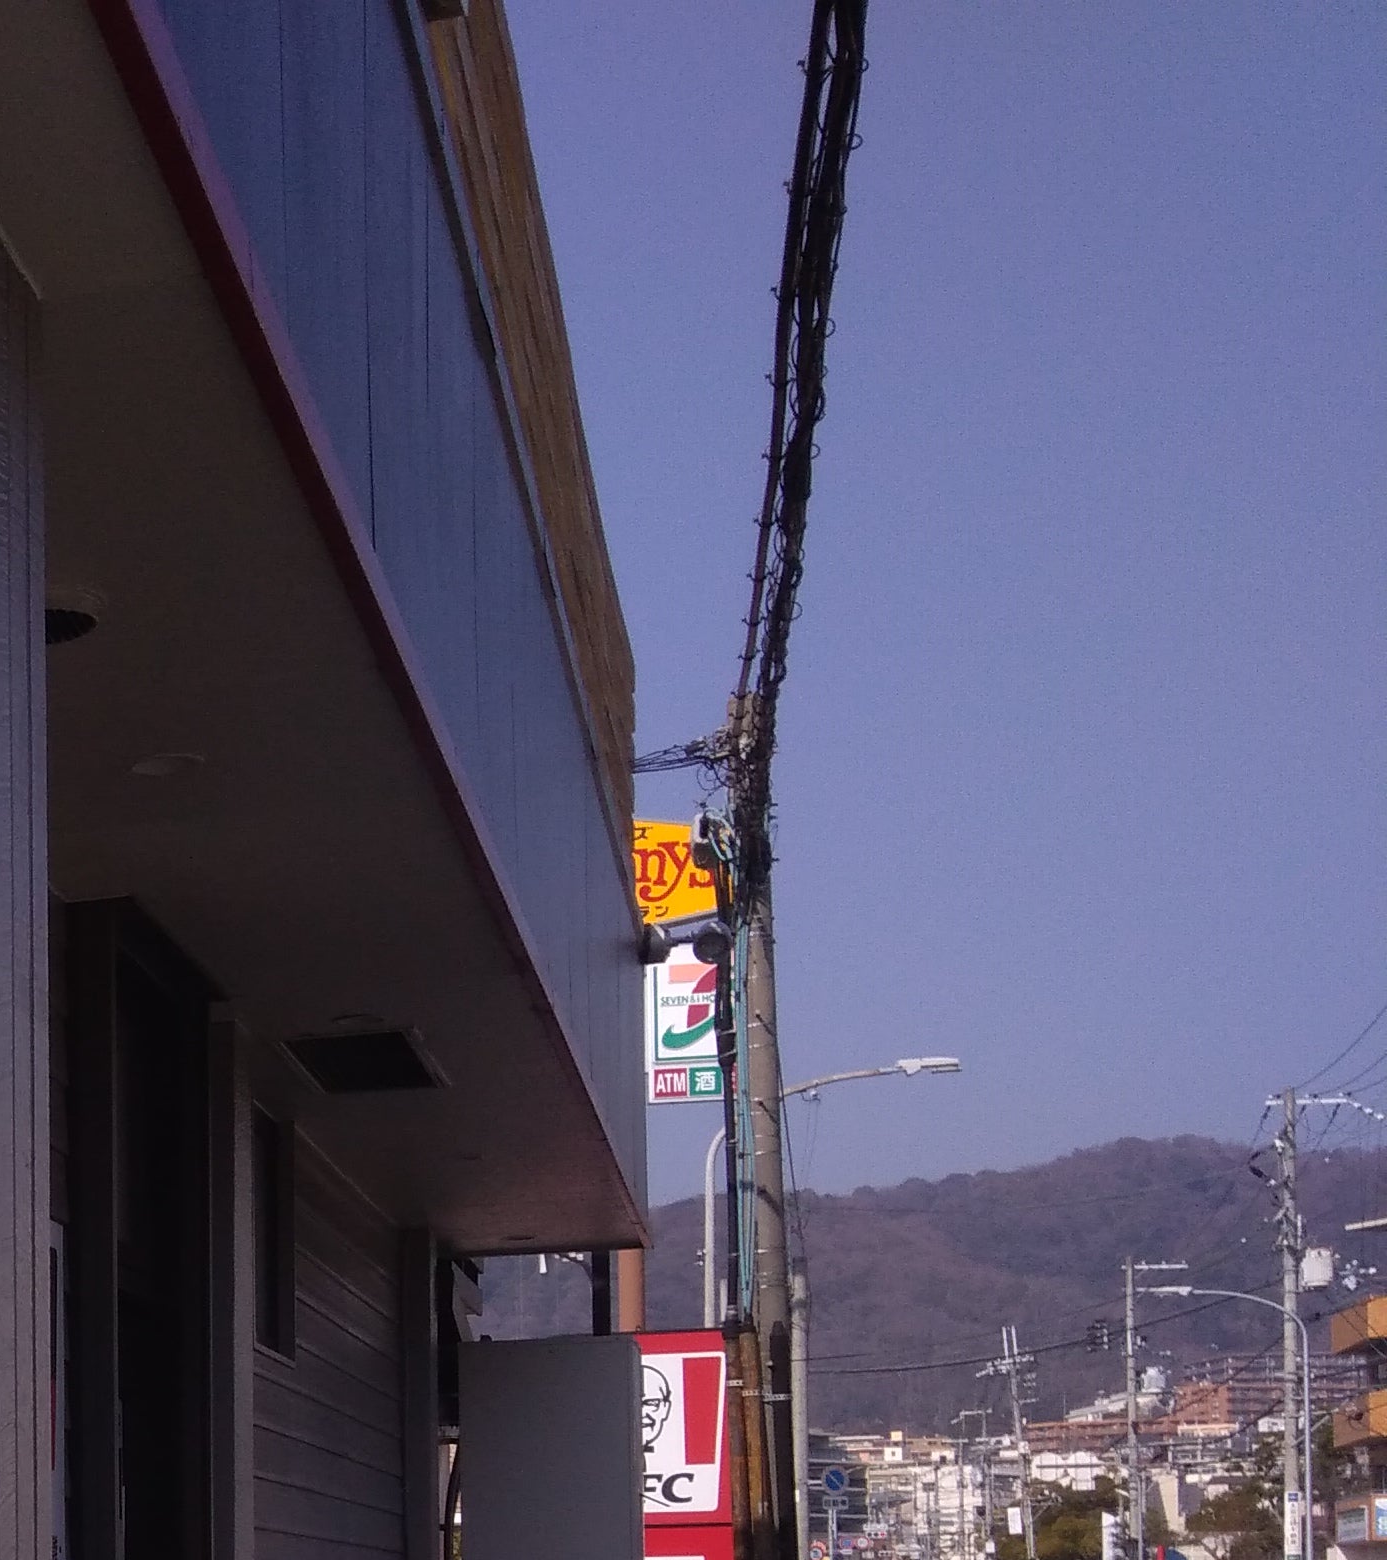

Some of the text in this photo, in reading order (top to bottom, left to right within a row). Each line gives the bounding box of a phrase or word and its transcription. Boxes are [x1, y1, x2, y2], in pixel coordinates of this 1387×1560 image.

[656, 1072, 686, 1093] ATM
[695, 1071, 716, 1092] 酒
[643, 1472, 694, 1503] FC
